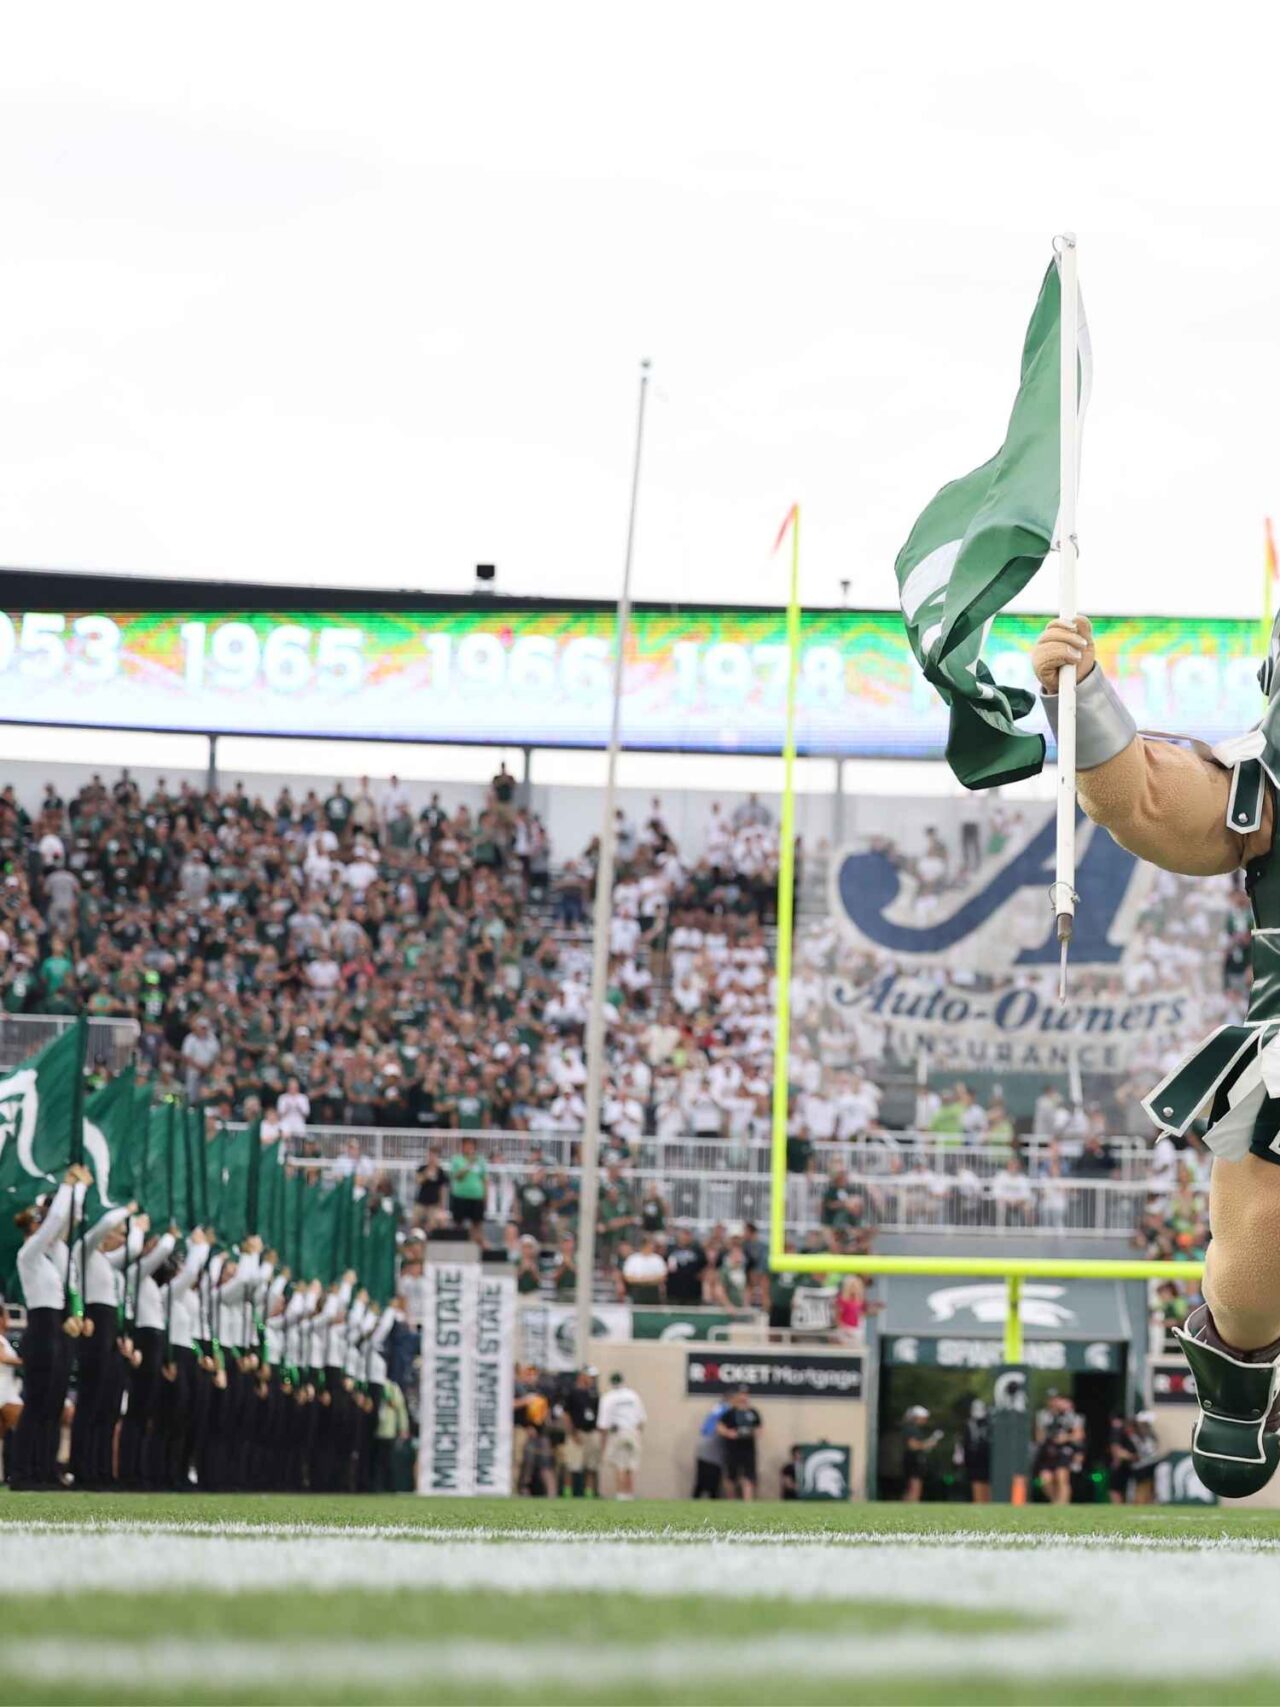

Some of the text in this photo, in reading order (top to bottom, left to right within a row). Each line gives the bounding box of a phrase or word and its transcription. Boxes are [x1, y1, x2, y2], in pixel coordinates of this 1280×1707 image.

[181, 622, 364, 694] 1965
[425, 633, 609, 702] 1966
[672, 643, 843, 708] 1978
[834, 973, 1188, 1033] Auto-Owners
[901, 1031, 1118, 1066] INSURANCE
[432, 1269, 462, 1489] MICHIGAN STATE
[474, 1284, 501, 1485] MICHIGAN STATE
